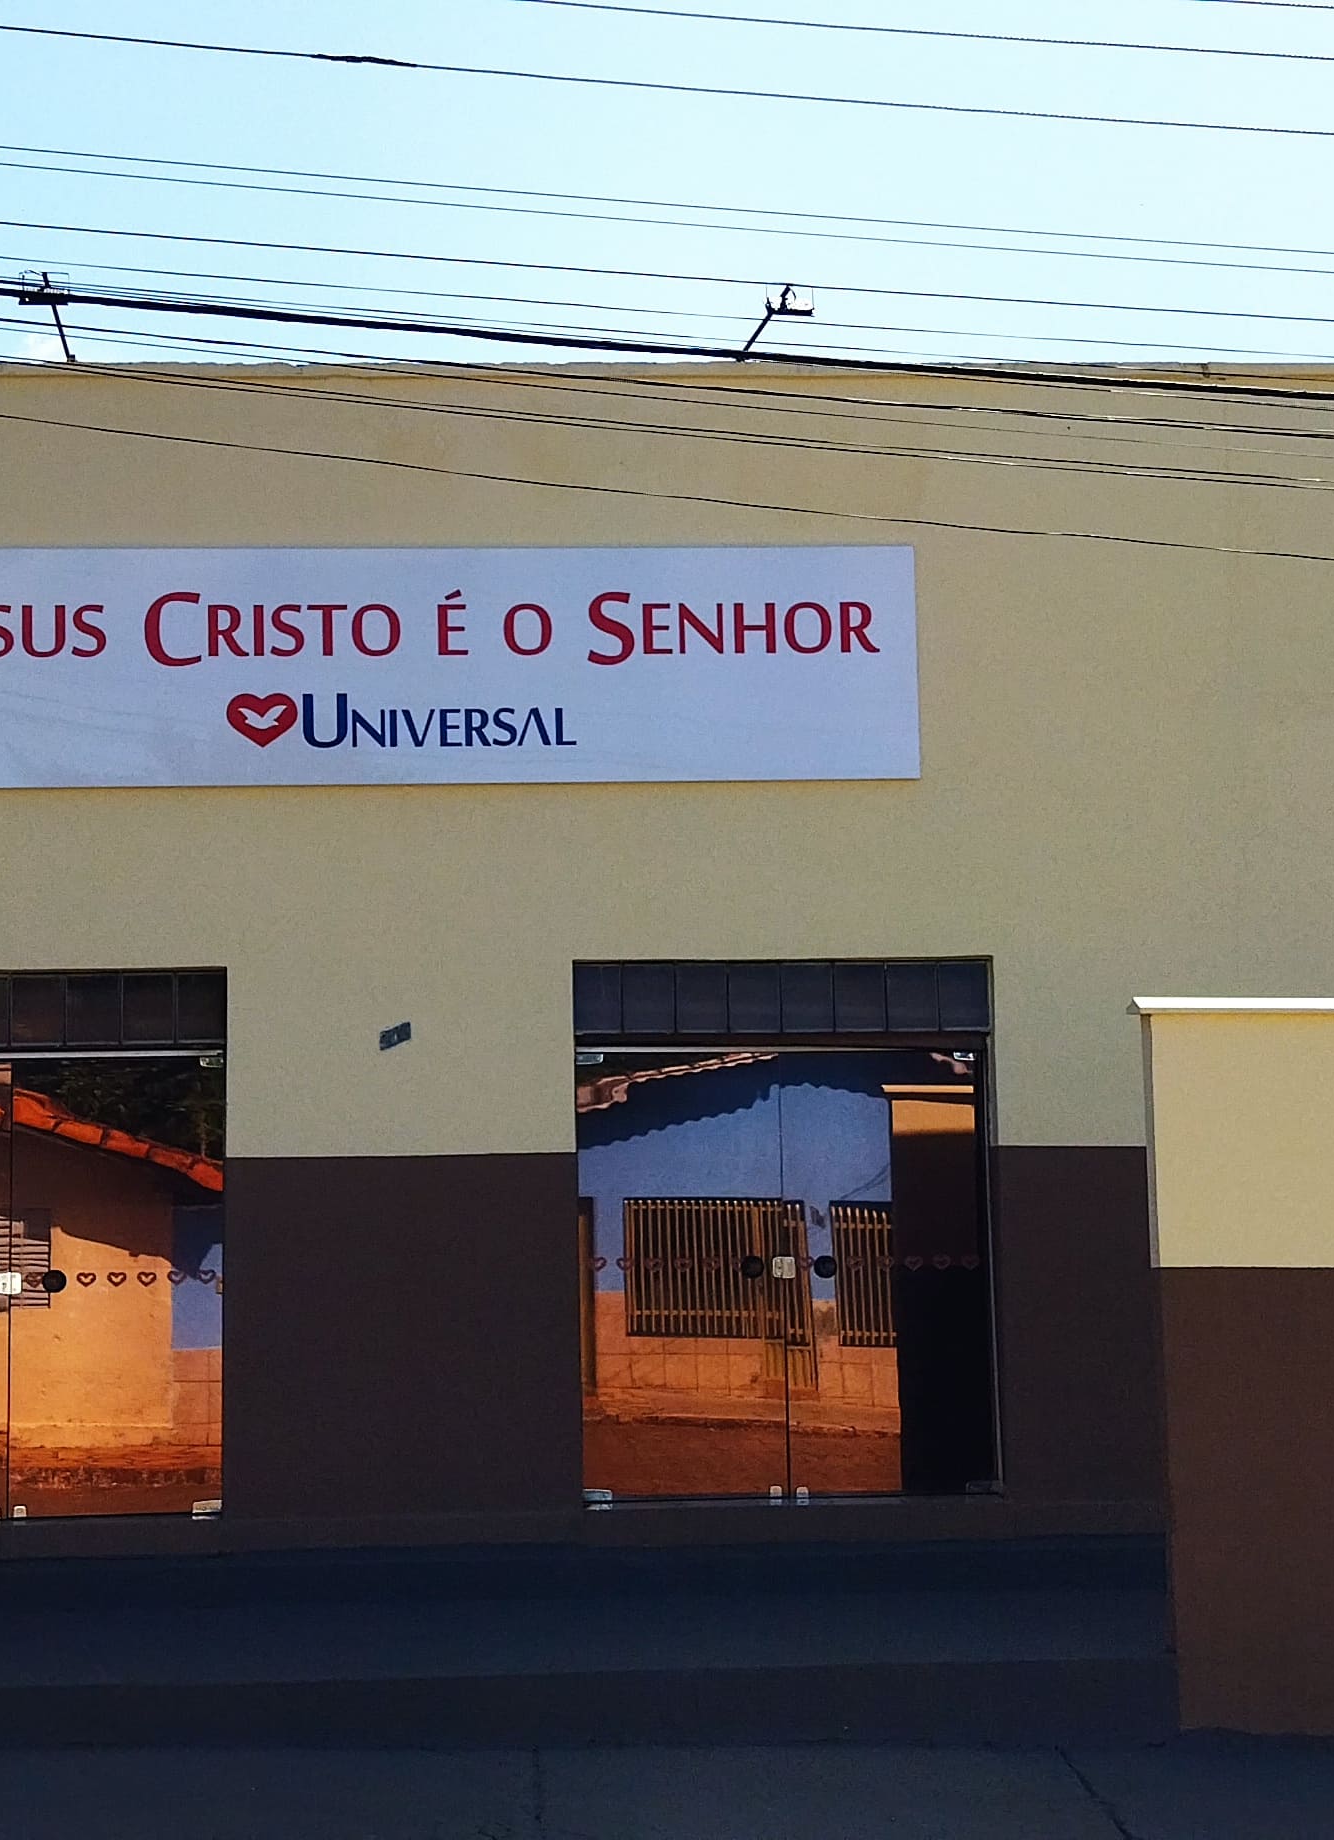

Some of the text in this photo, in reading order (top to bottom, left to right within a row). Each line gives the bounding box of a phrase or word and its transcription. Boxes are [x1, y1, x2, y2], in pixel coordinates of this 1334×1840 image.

[143, 591, 401, 667] CRISTO
[436, 588, 469, 656] É
[503, 603, 553, 656] O
[587, 591, 881, 666] SENHOR
[302, 692, 578, 749] UNIVERSAL
